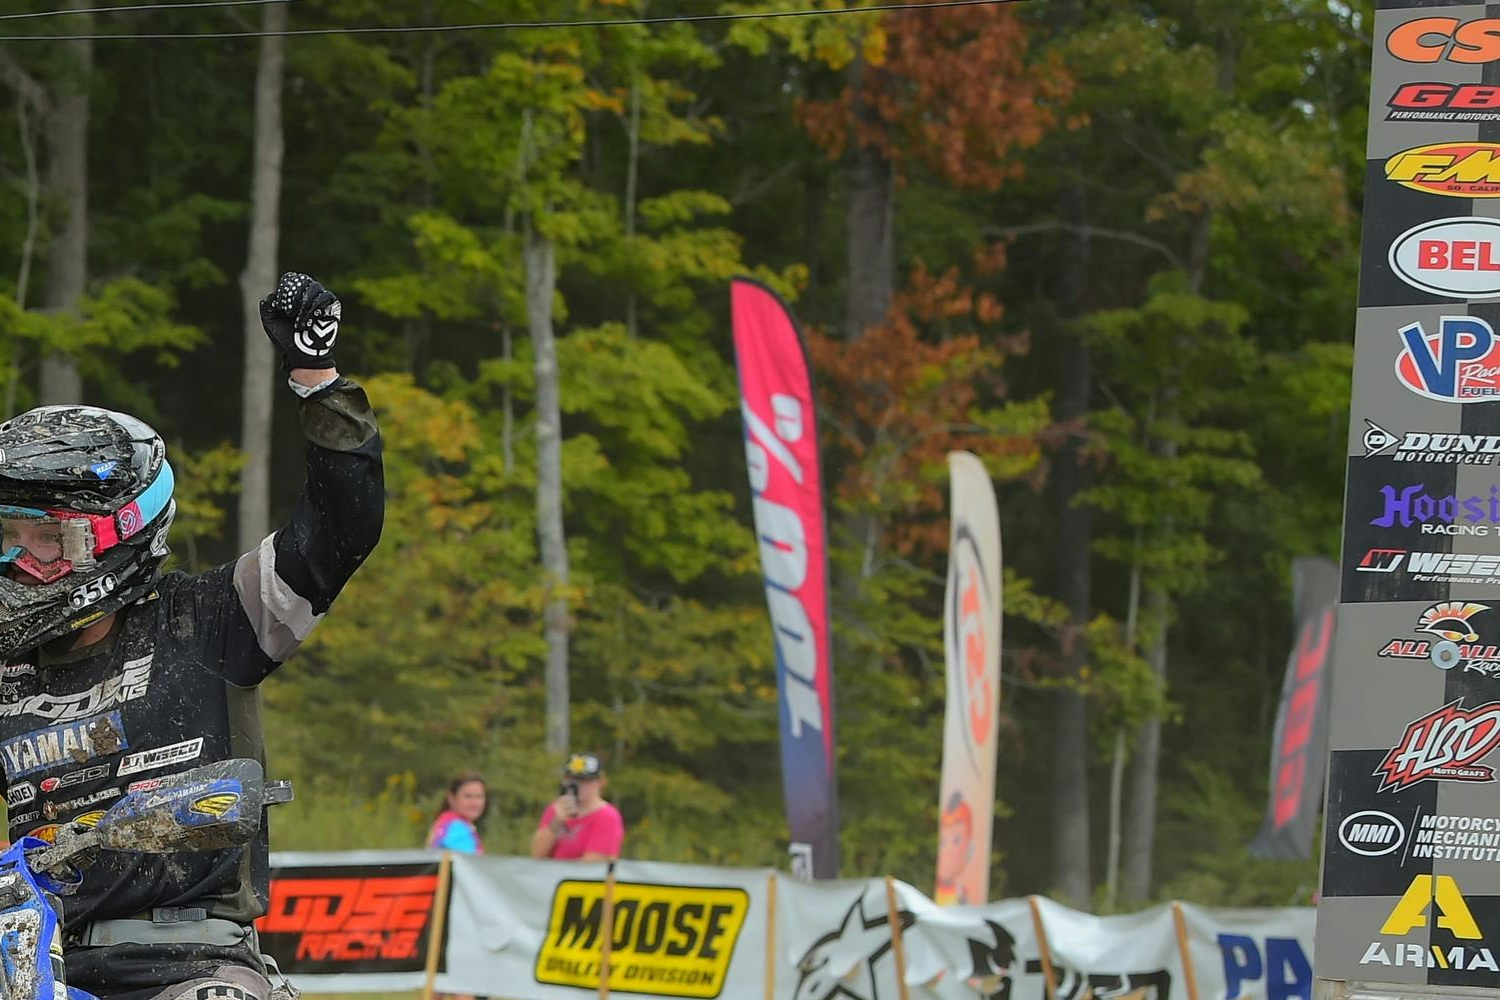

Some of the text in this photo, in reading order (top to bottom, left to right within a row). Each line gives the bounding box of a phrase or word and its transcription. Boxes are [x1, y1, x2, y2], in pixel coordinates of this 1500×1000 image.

[1390, 111, 1454, 120] PERFORMANCE
[1401, 318, 1492, 398] VP
[1393, 452, 1494, 464] MOTORCYCLE
[1421, 524, 1488, 537] RACING
[70, 574, 117, 608] 650
[1412, 574, 1483, 584] Performance
[1380, 641, 1430, 658] ALL
[4, 721, 123, 774] YAMA
[1347, 823, 1396, 844] MMI
[255, 874, 440, 933] OOSE
[555, 896, 733, 960] MOOSE
[1358, 942, 1500, 972] ARMA
[624, 963, 717, 987] DIVISION
